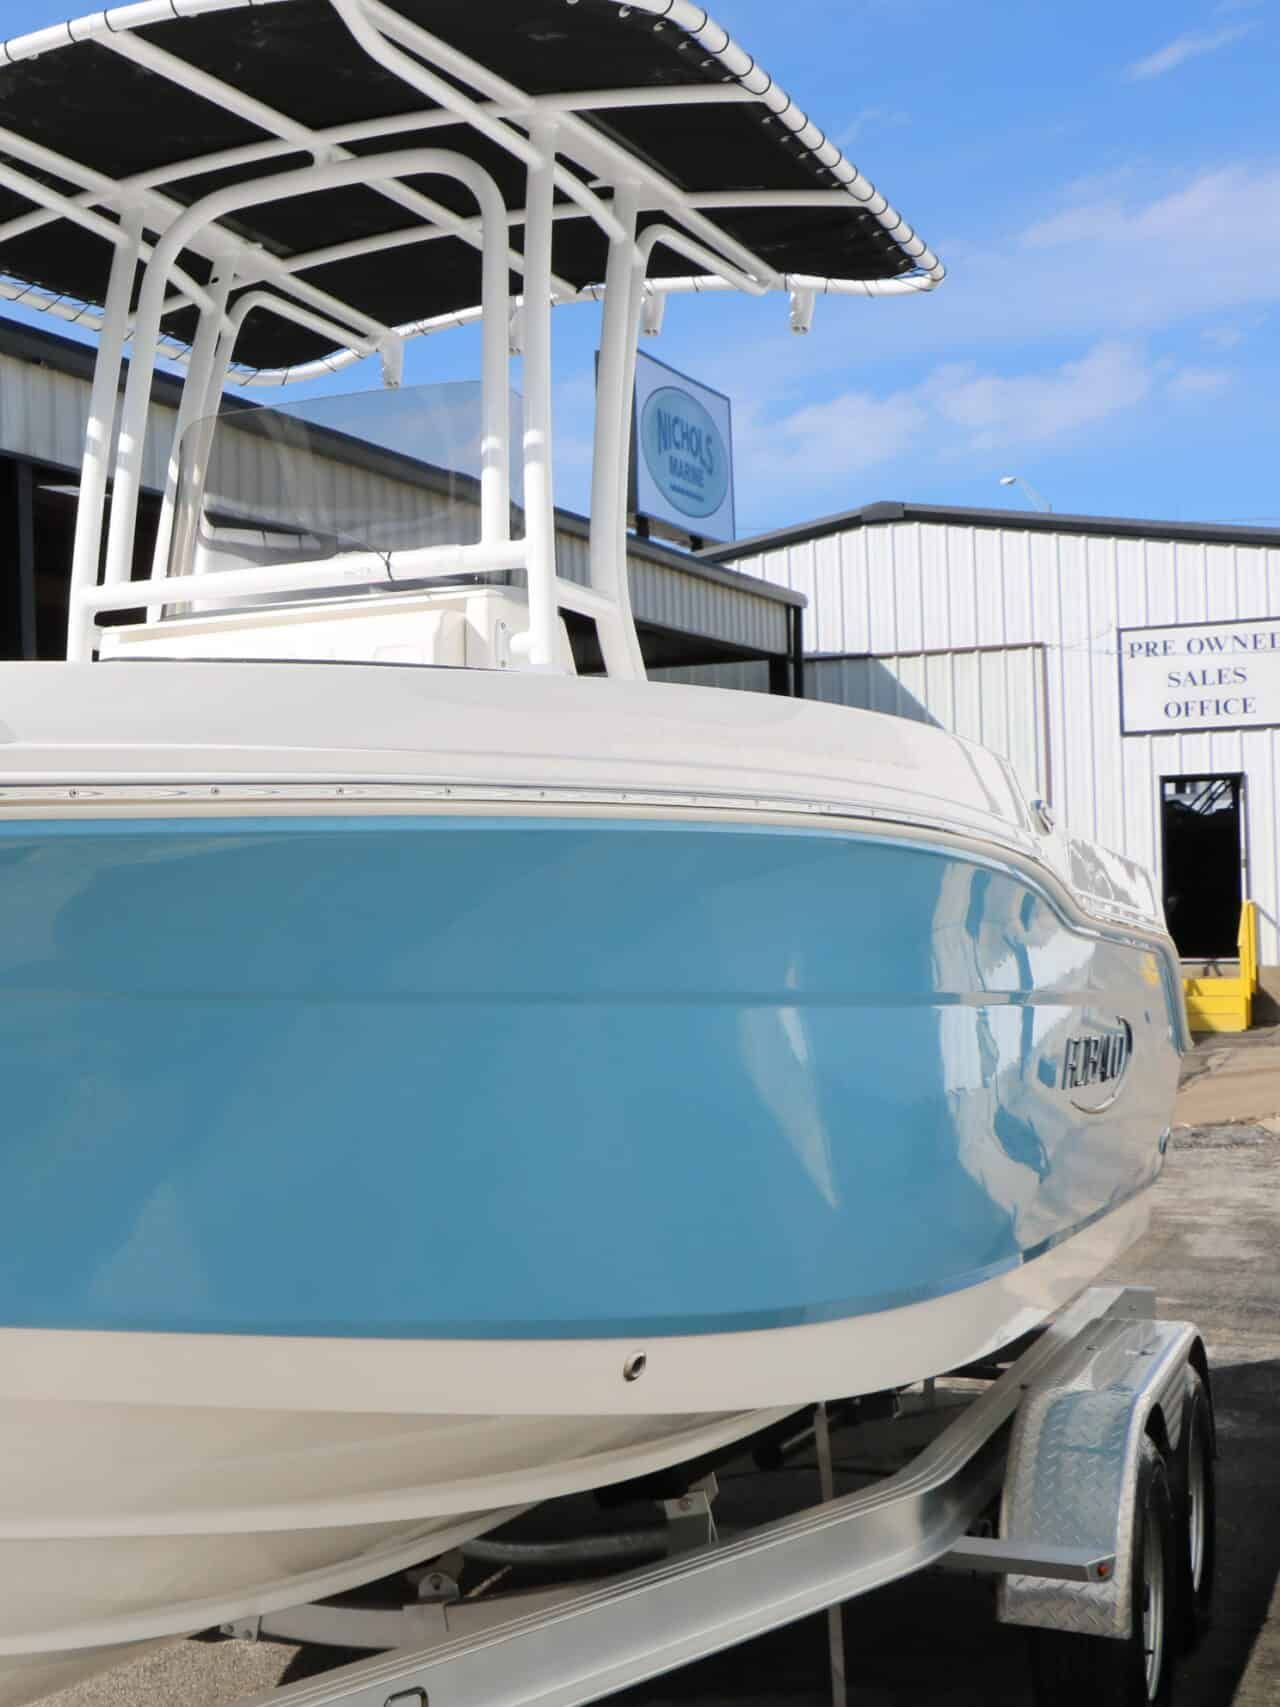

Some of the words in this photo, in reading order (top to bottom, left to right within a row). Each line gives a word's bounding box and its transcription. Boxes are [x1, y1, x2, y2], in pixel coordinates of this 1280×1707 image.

[657, 407, 714, 476] NICHOLS
[669, 455, 706, 488] MARINE
[1129, 639, 1176, 659] PRE
[1167, 667, 1248, 688] SALES
[1164, 697, 1257, 719] OFFICE
